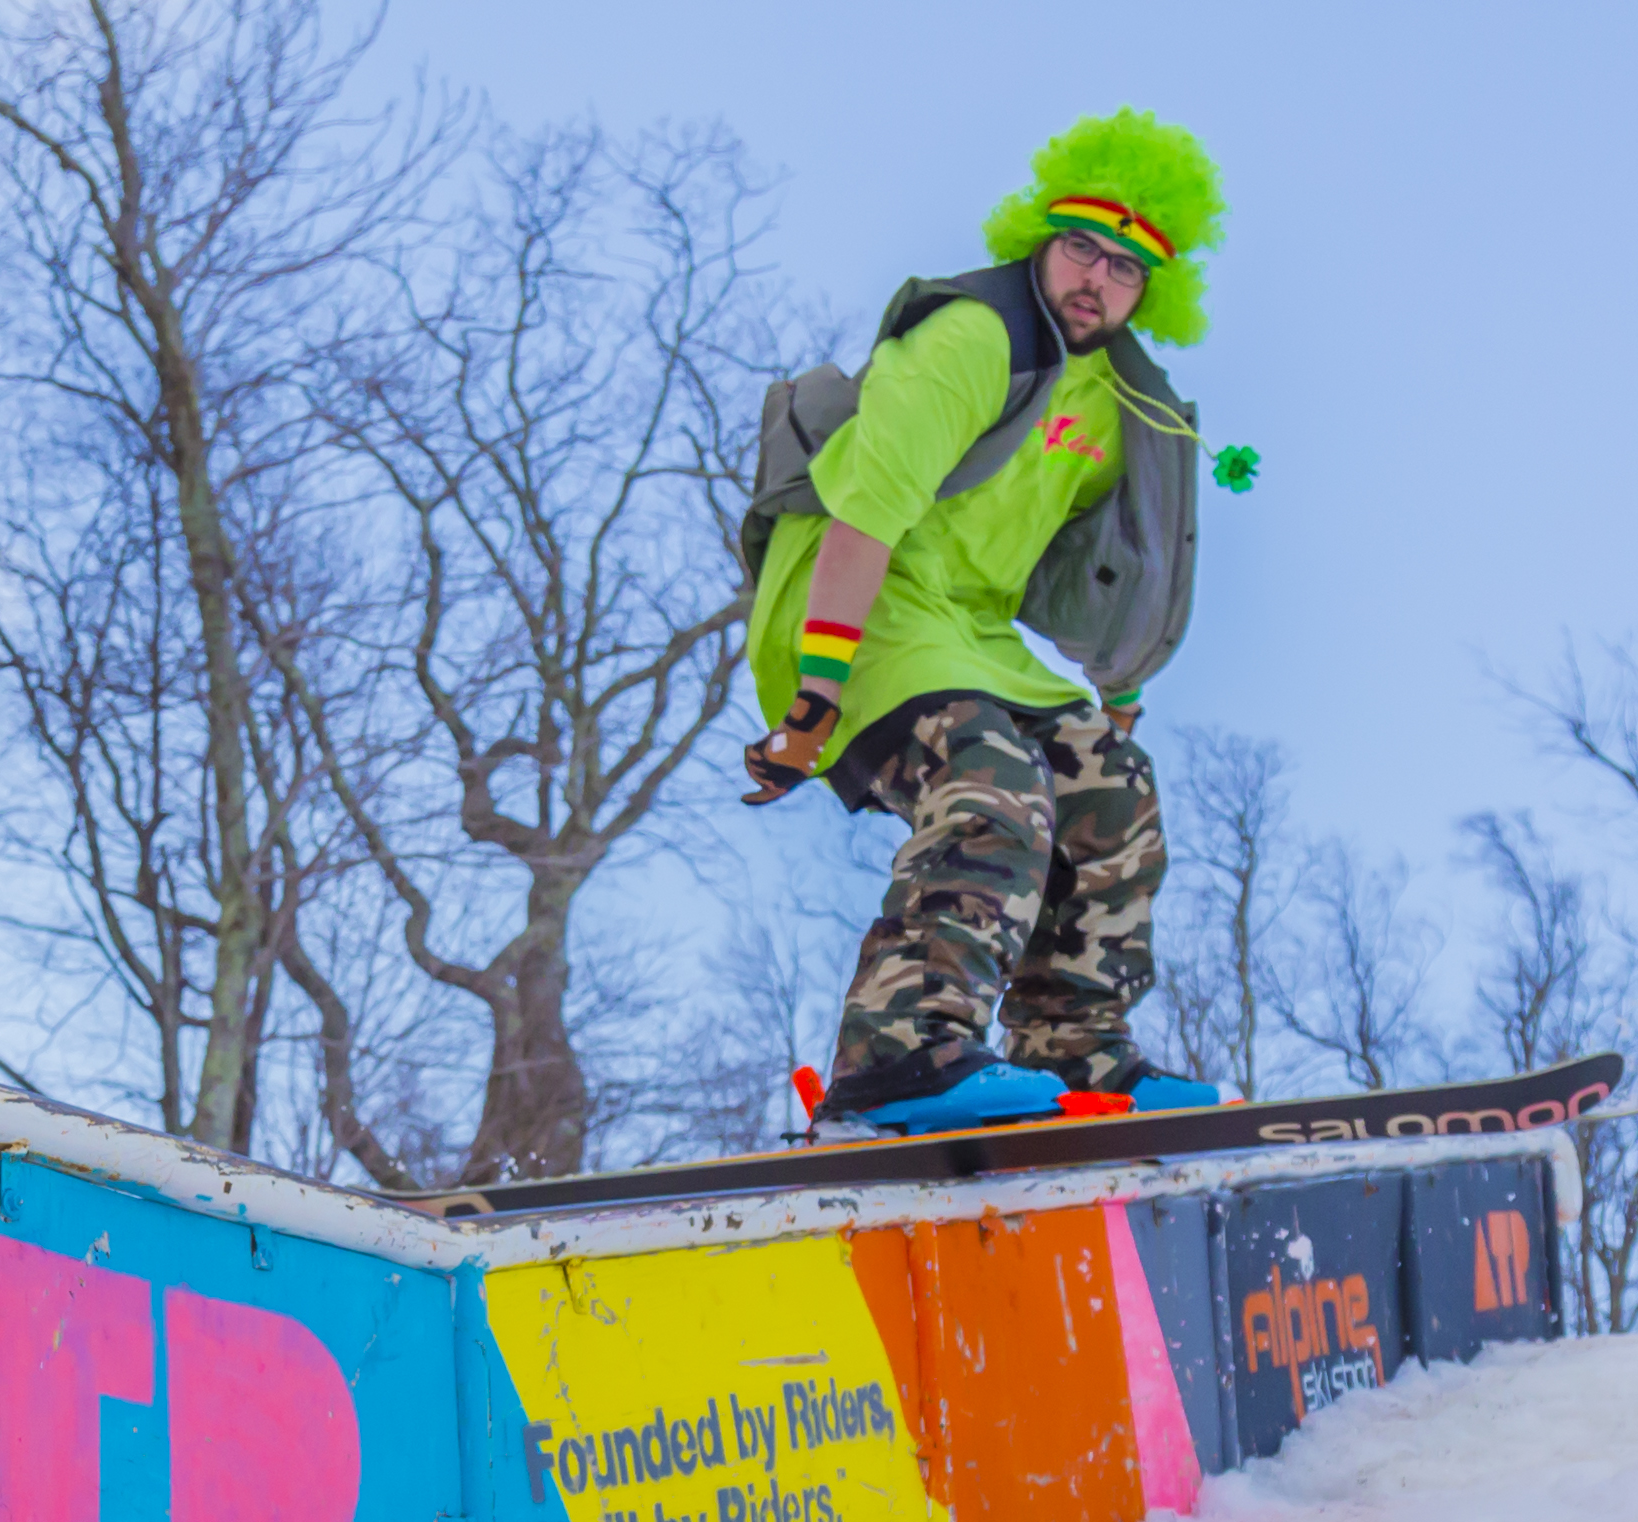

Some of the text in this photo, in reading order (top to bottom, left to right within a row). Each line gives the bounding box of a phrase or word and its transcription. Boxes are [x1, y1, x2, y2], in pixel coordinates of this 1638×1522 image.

[522, 1377, 895, 1503] Founded by Riders,
